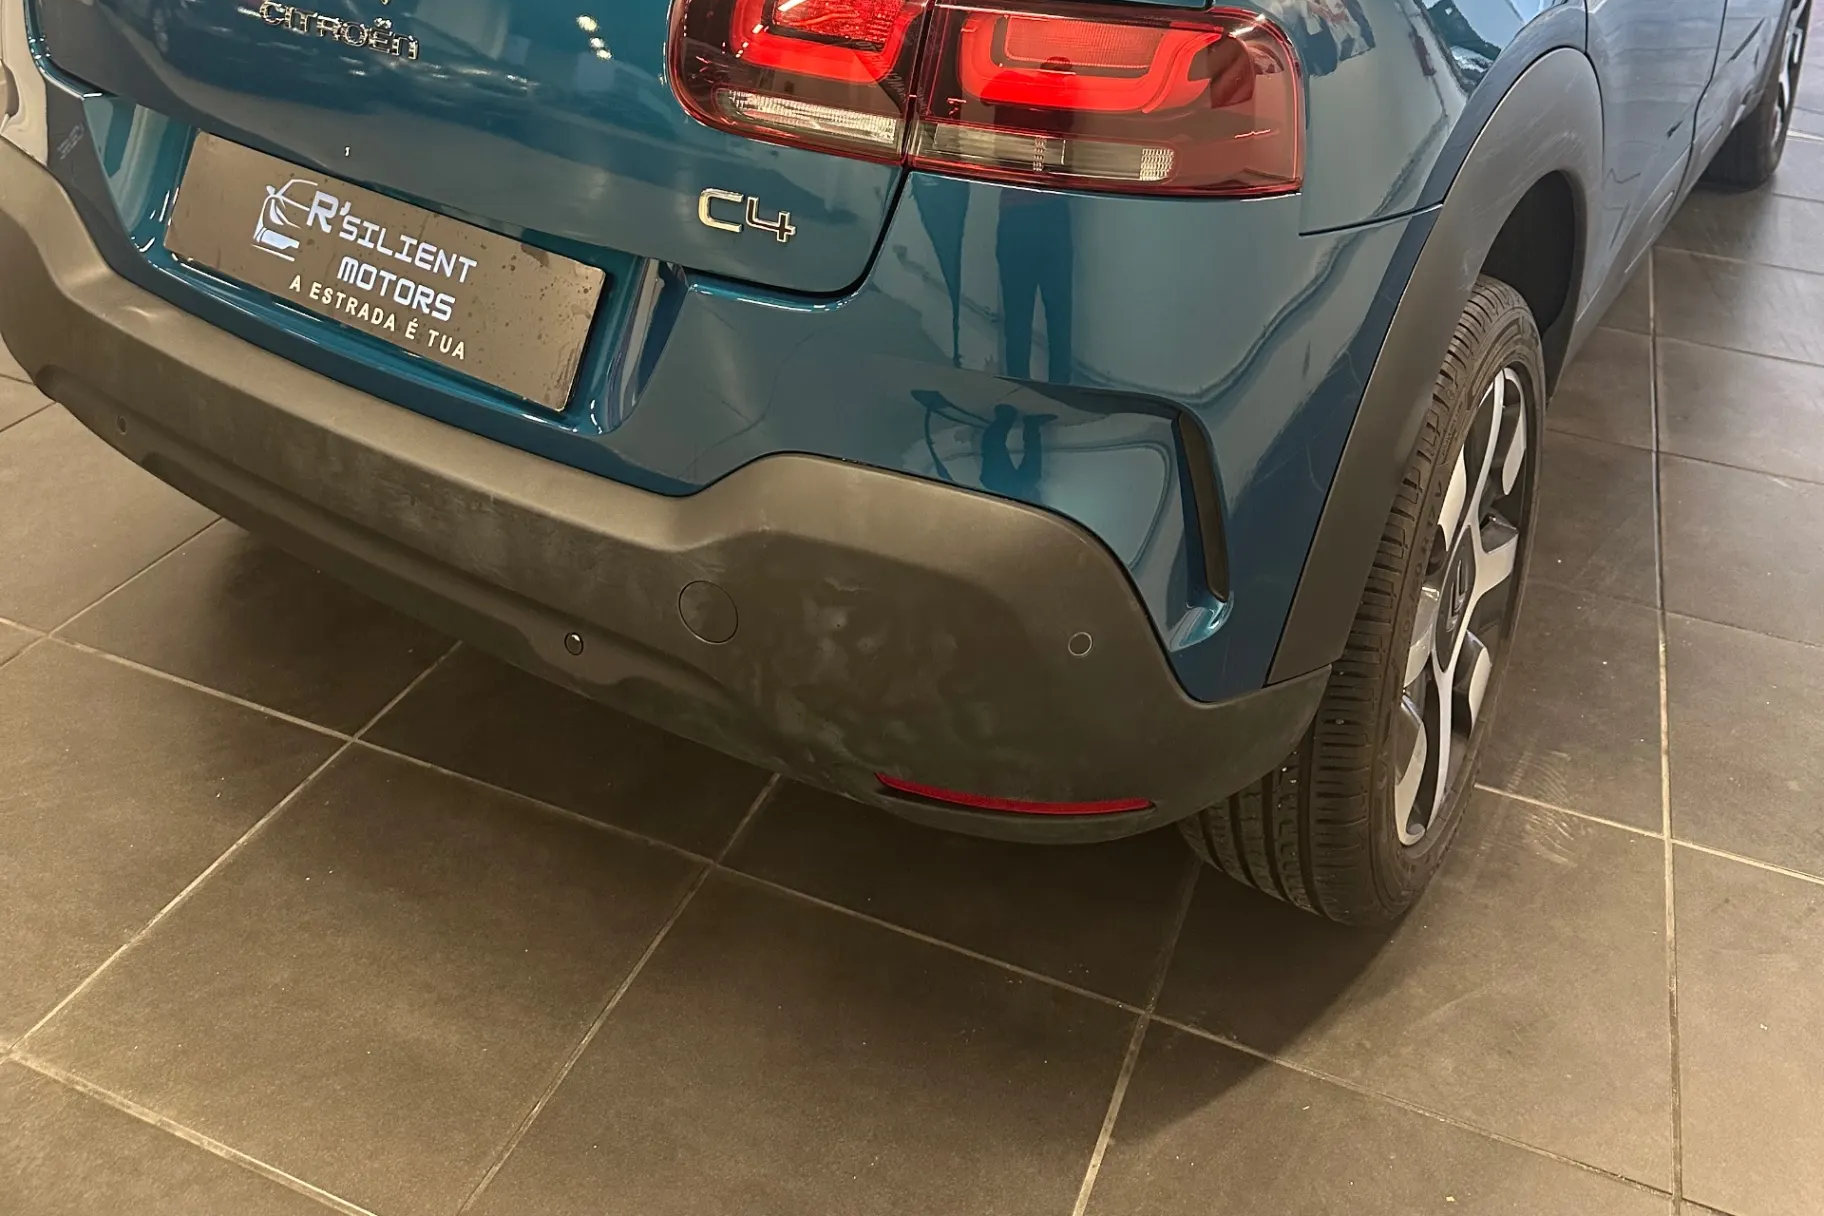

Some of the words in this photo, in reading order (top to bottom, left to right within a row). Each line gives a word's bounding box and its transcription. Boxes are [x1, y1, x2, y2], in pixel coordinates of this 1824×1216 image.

[259, 0, 420, 60] CITROËN
[306, 190, 477, 284] R'SILIENT
[698, 187, 797, 243] C4
[289, 274, 302, 293] A
[309, 281, 396, 333] ESTRADA
[404, 317, 420, 340] É
[428, 329, 466, 361] TUA
[337, 255, 456, 322] MOTORS
